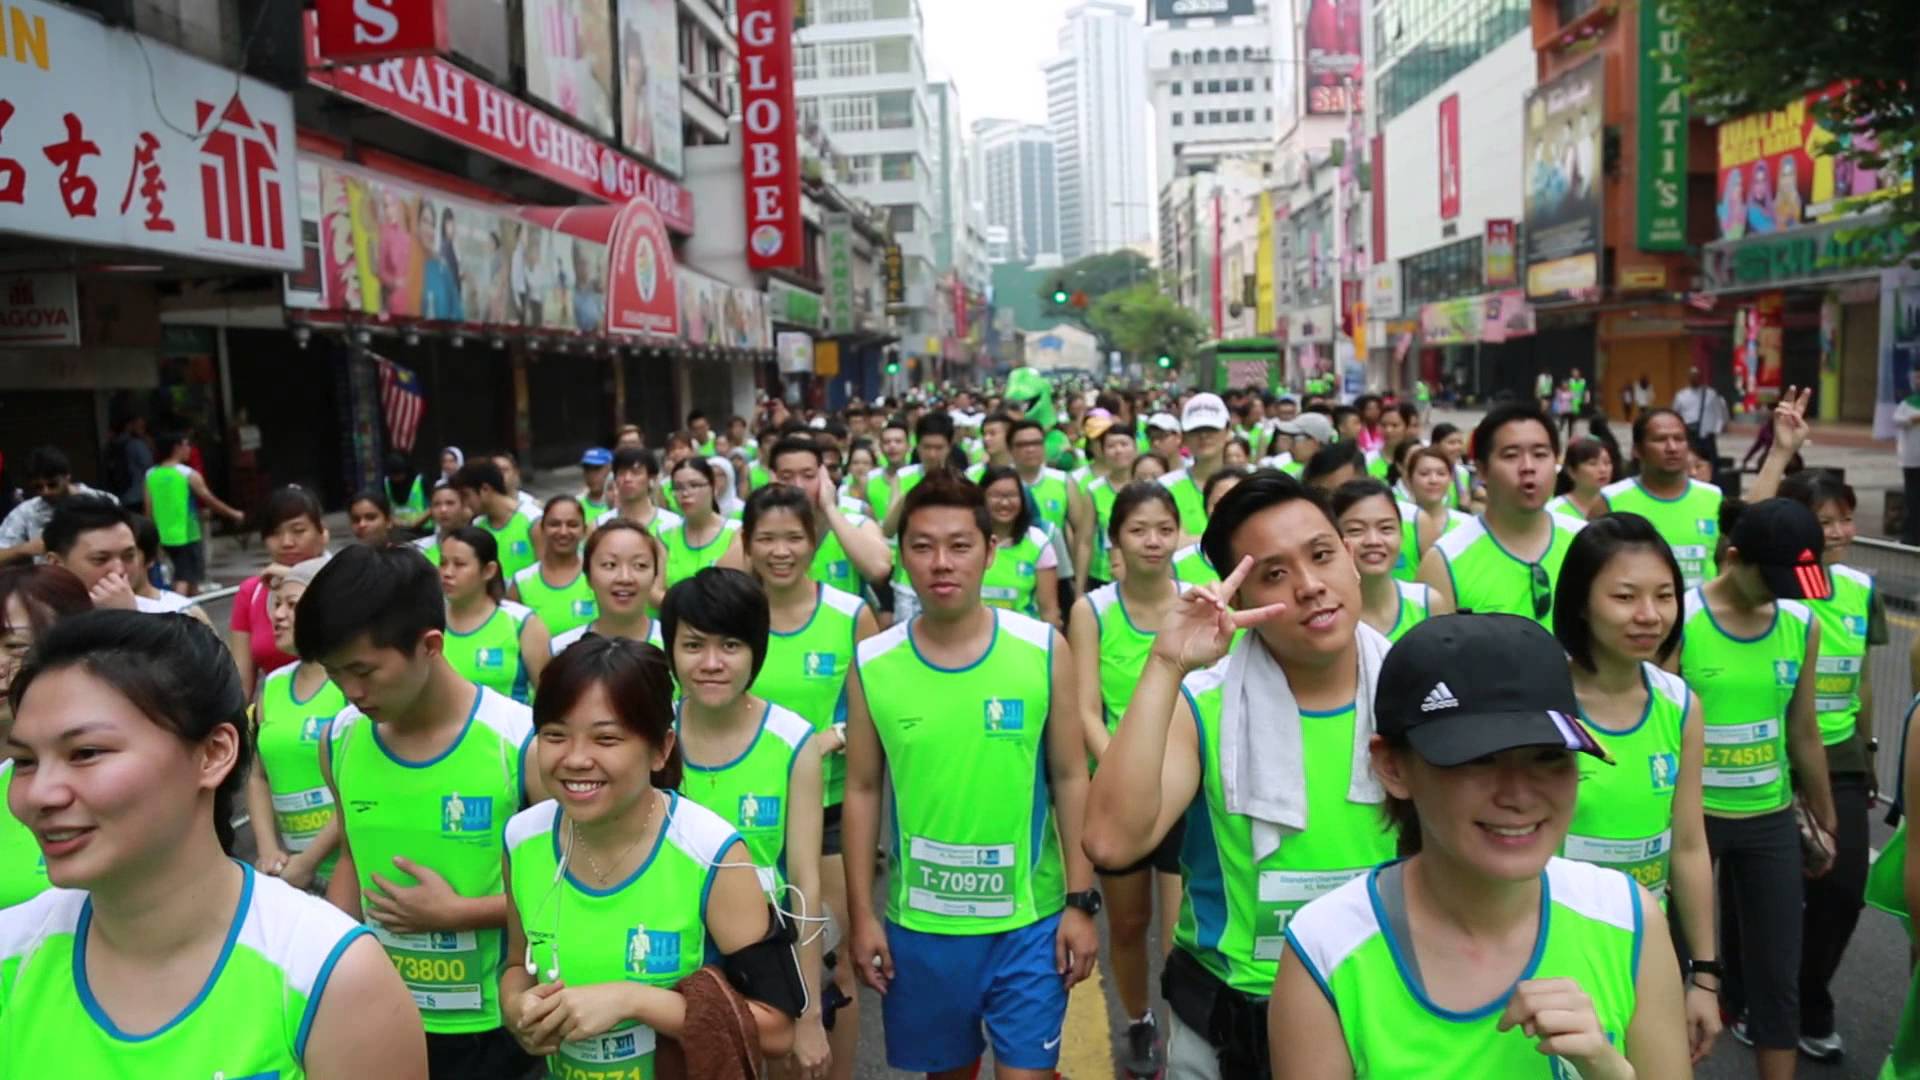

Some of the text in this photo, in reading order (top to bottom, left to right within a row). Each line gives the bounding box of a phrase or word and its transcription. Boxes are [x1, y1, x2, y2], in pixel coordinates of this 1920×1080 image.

[475, 83, 599, 182] HUGHES
[618, 158, 681, 217] GLOBE
[742, 10, 783, 221] GLOBE
[1421, 697, 1460, 712] adidas
[919, 865, 1004, 893] T-70970
